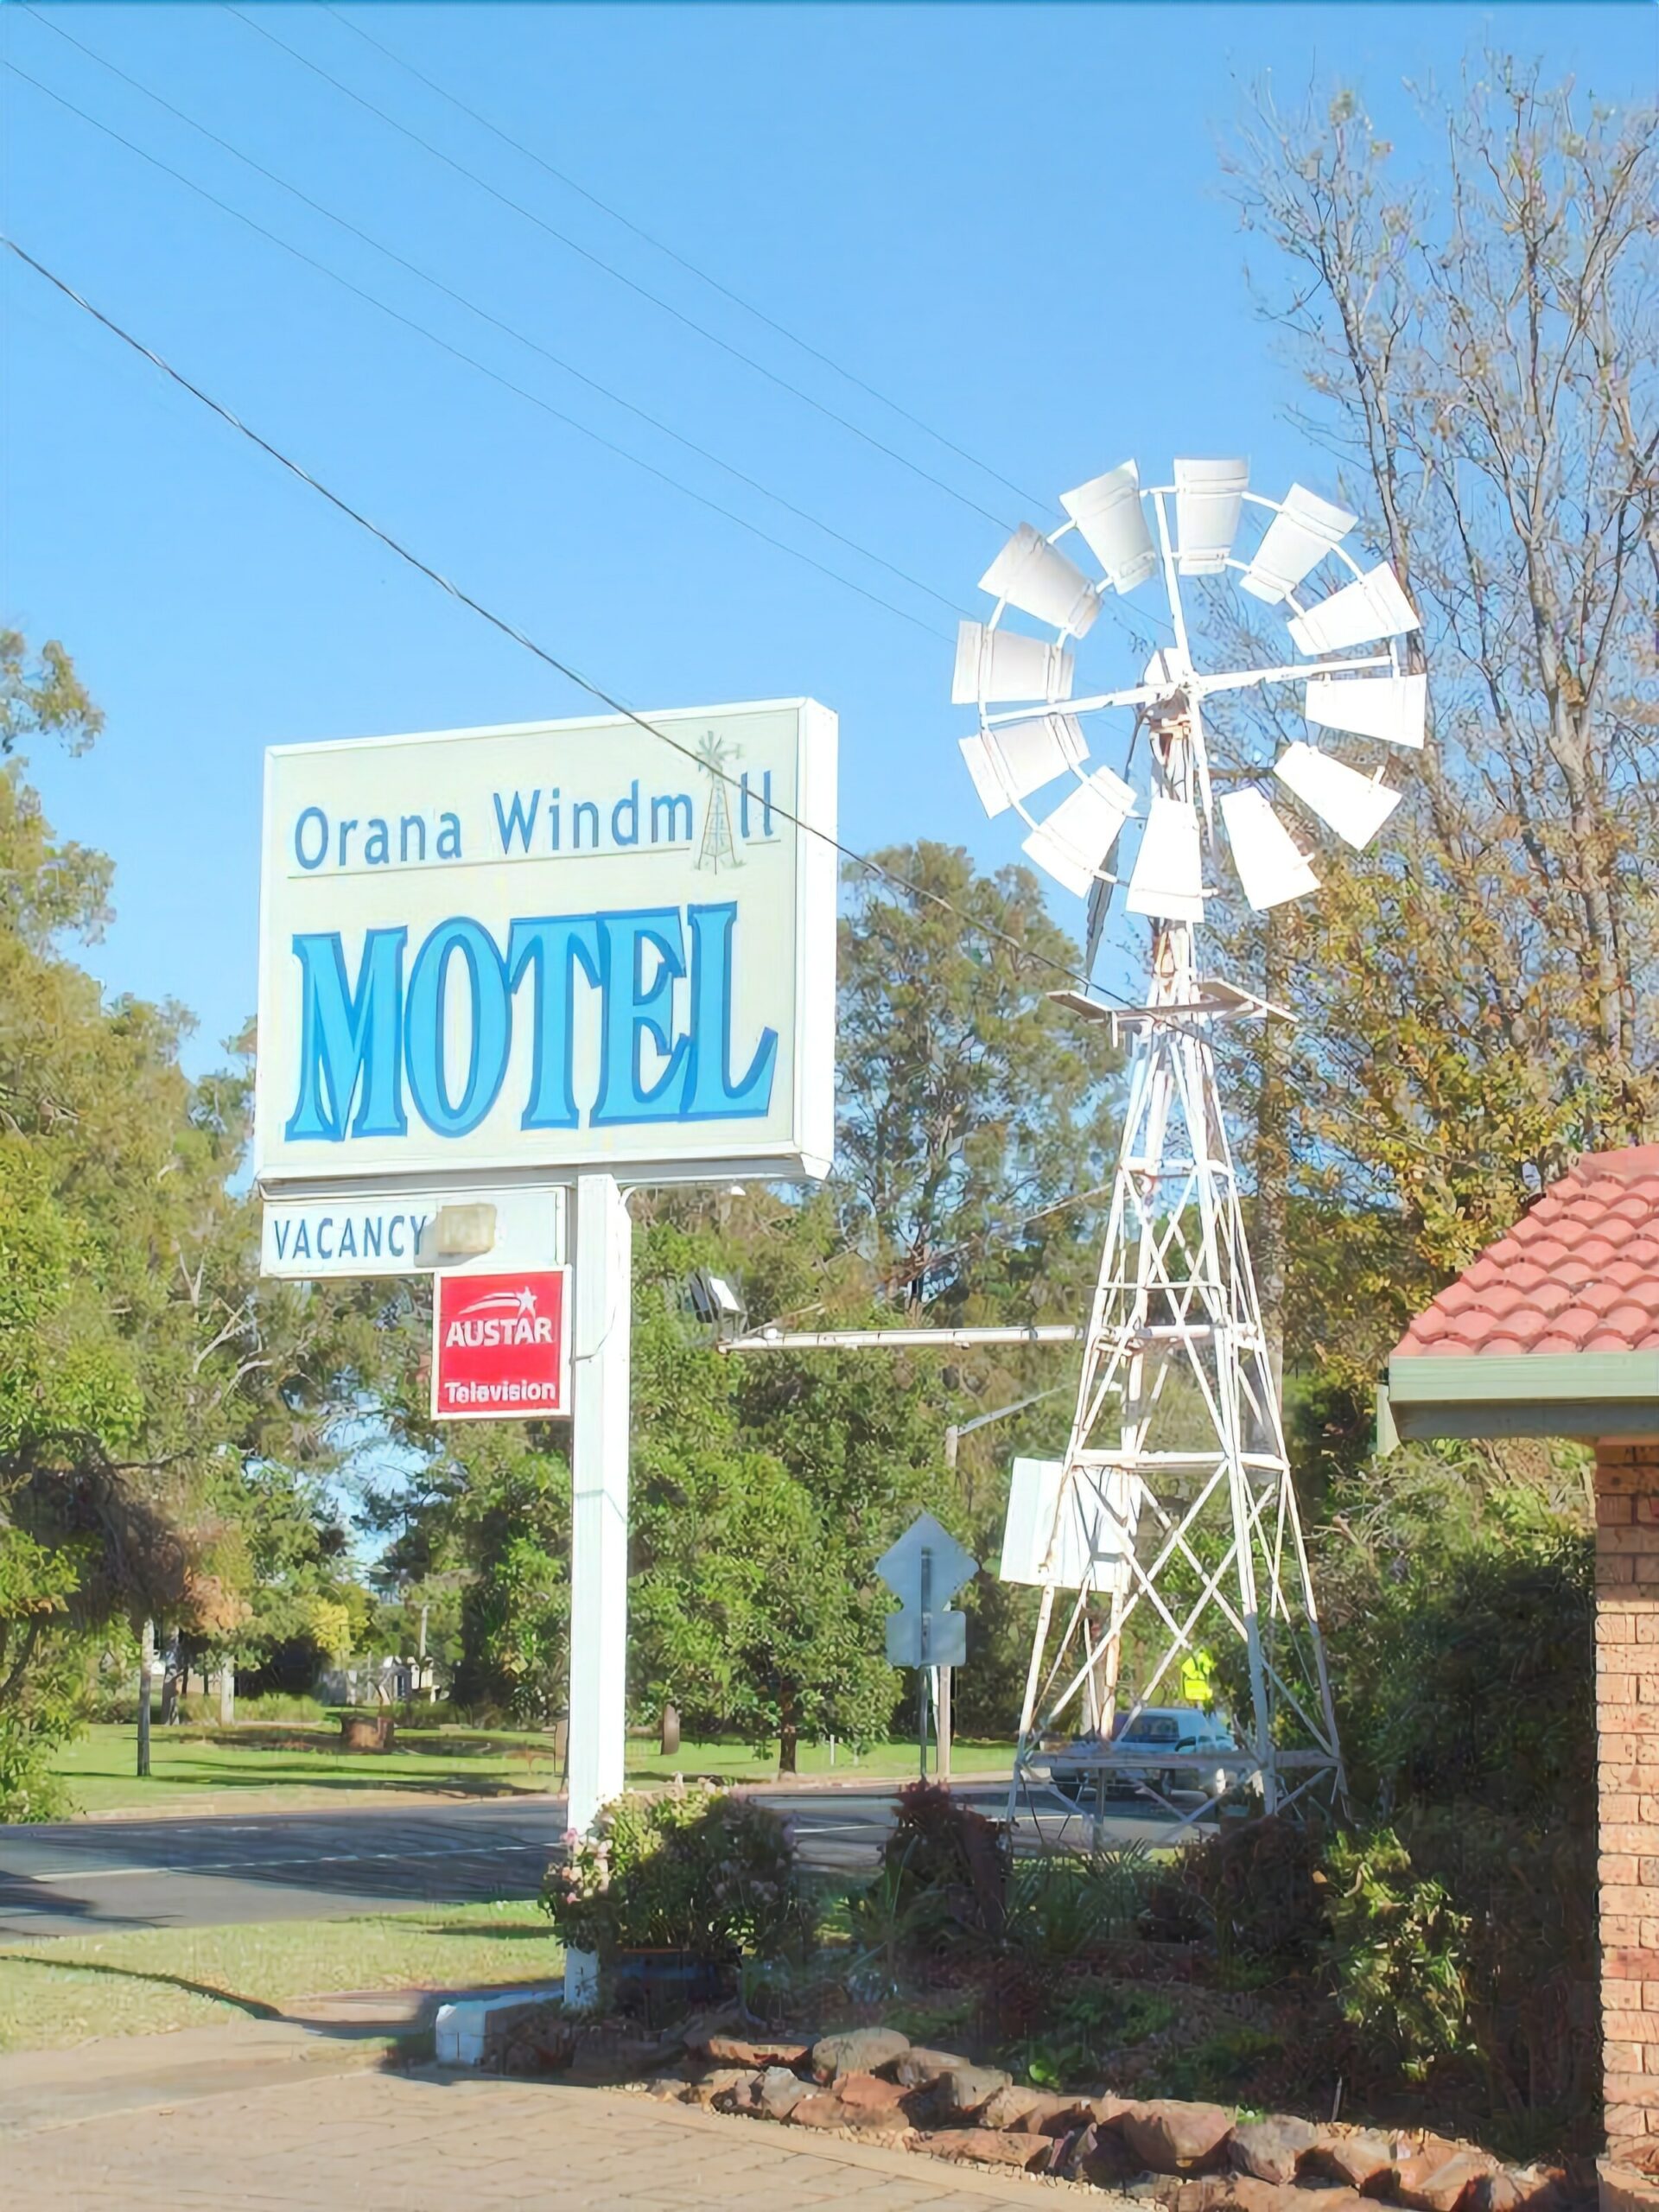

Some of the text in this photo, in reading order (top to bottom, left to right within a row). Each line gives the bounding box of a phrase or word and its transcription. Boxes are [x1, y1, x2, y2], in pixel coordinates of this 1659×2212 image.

[294, 805, 463, 870] Orana
[284, 900, 778, 1141] MOTEL
[274, 1214, 428, 1260] VACANCY
[445, 1316, 554, 1348] AUSTAR
[445, 1380, 556, 1404] Television
